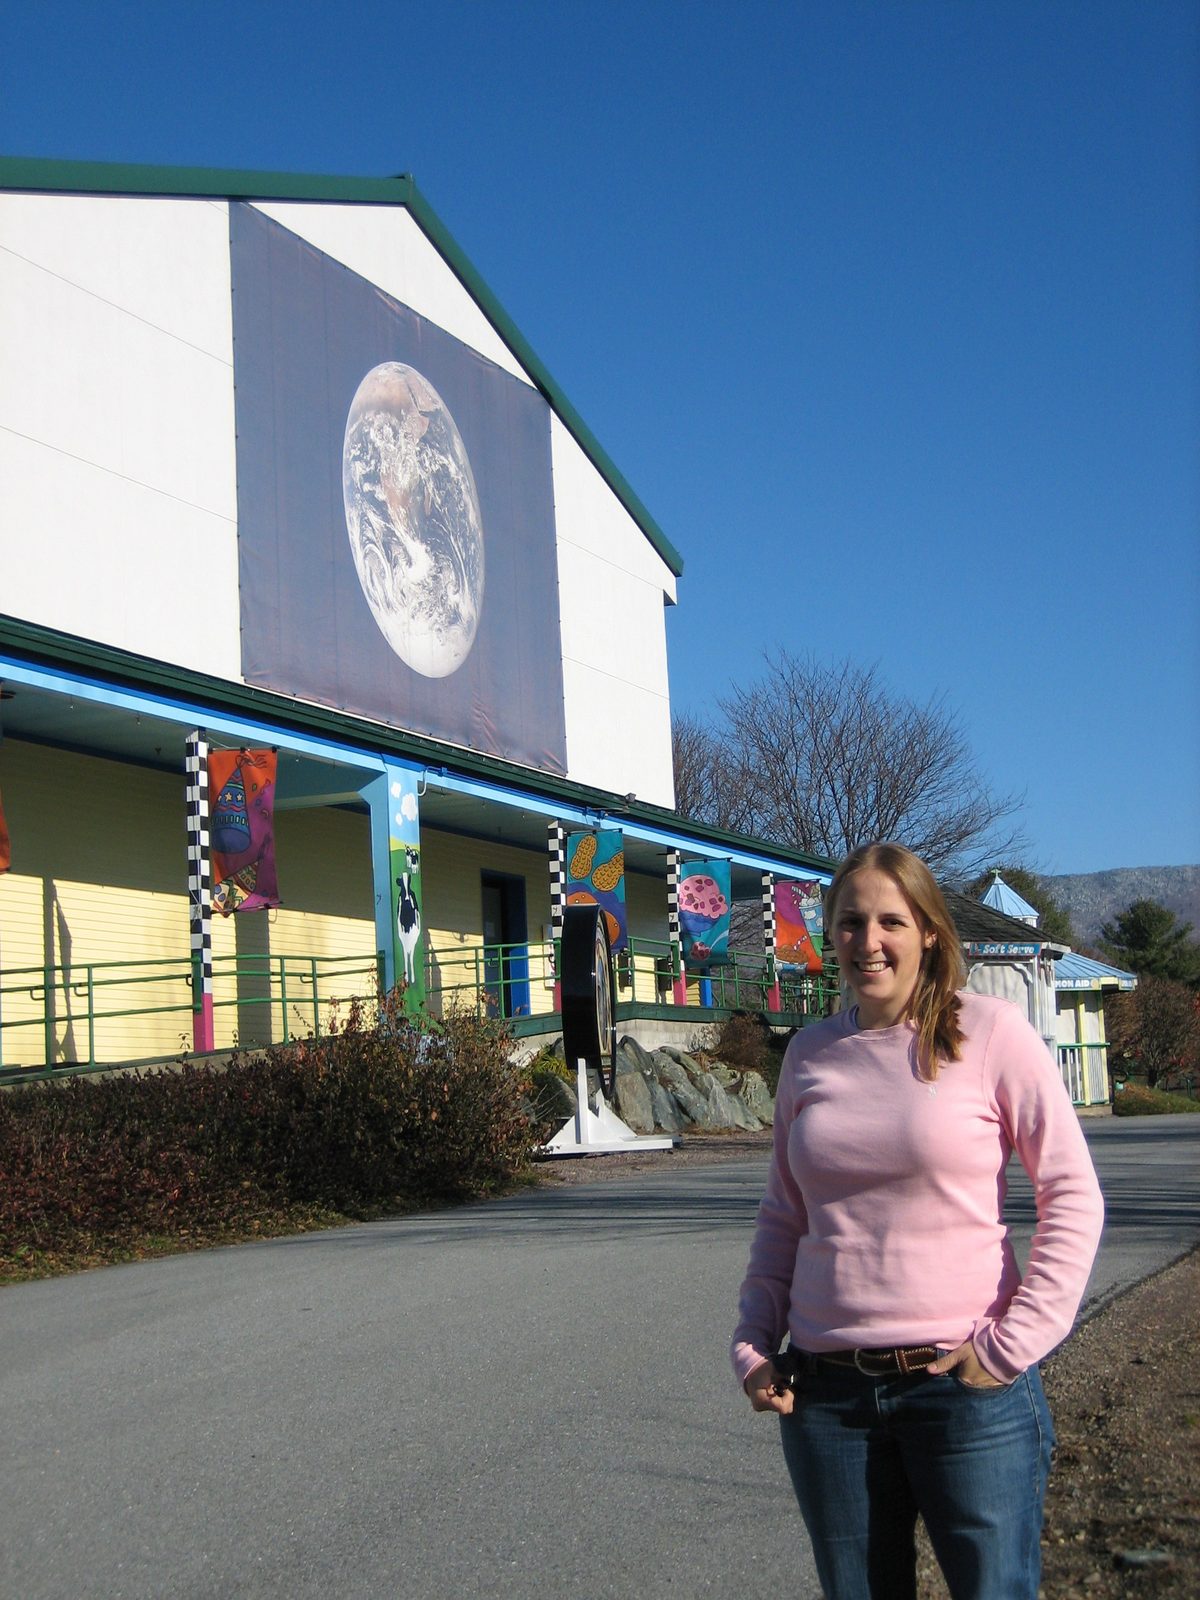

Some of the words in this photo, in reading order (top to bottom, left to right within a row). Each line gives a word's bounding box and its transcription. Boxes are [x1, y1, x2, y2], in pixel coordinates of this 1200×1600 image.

[983, 943, 1006, 954] Soft
[1007, 944, 1035, 954] Serve
[1075, 979, 1090, 988] AID
